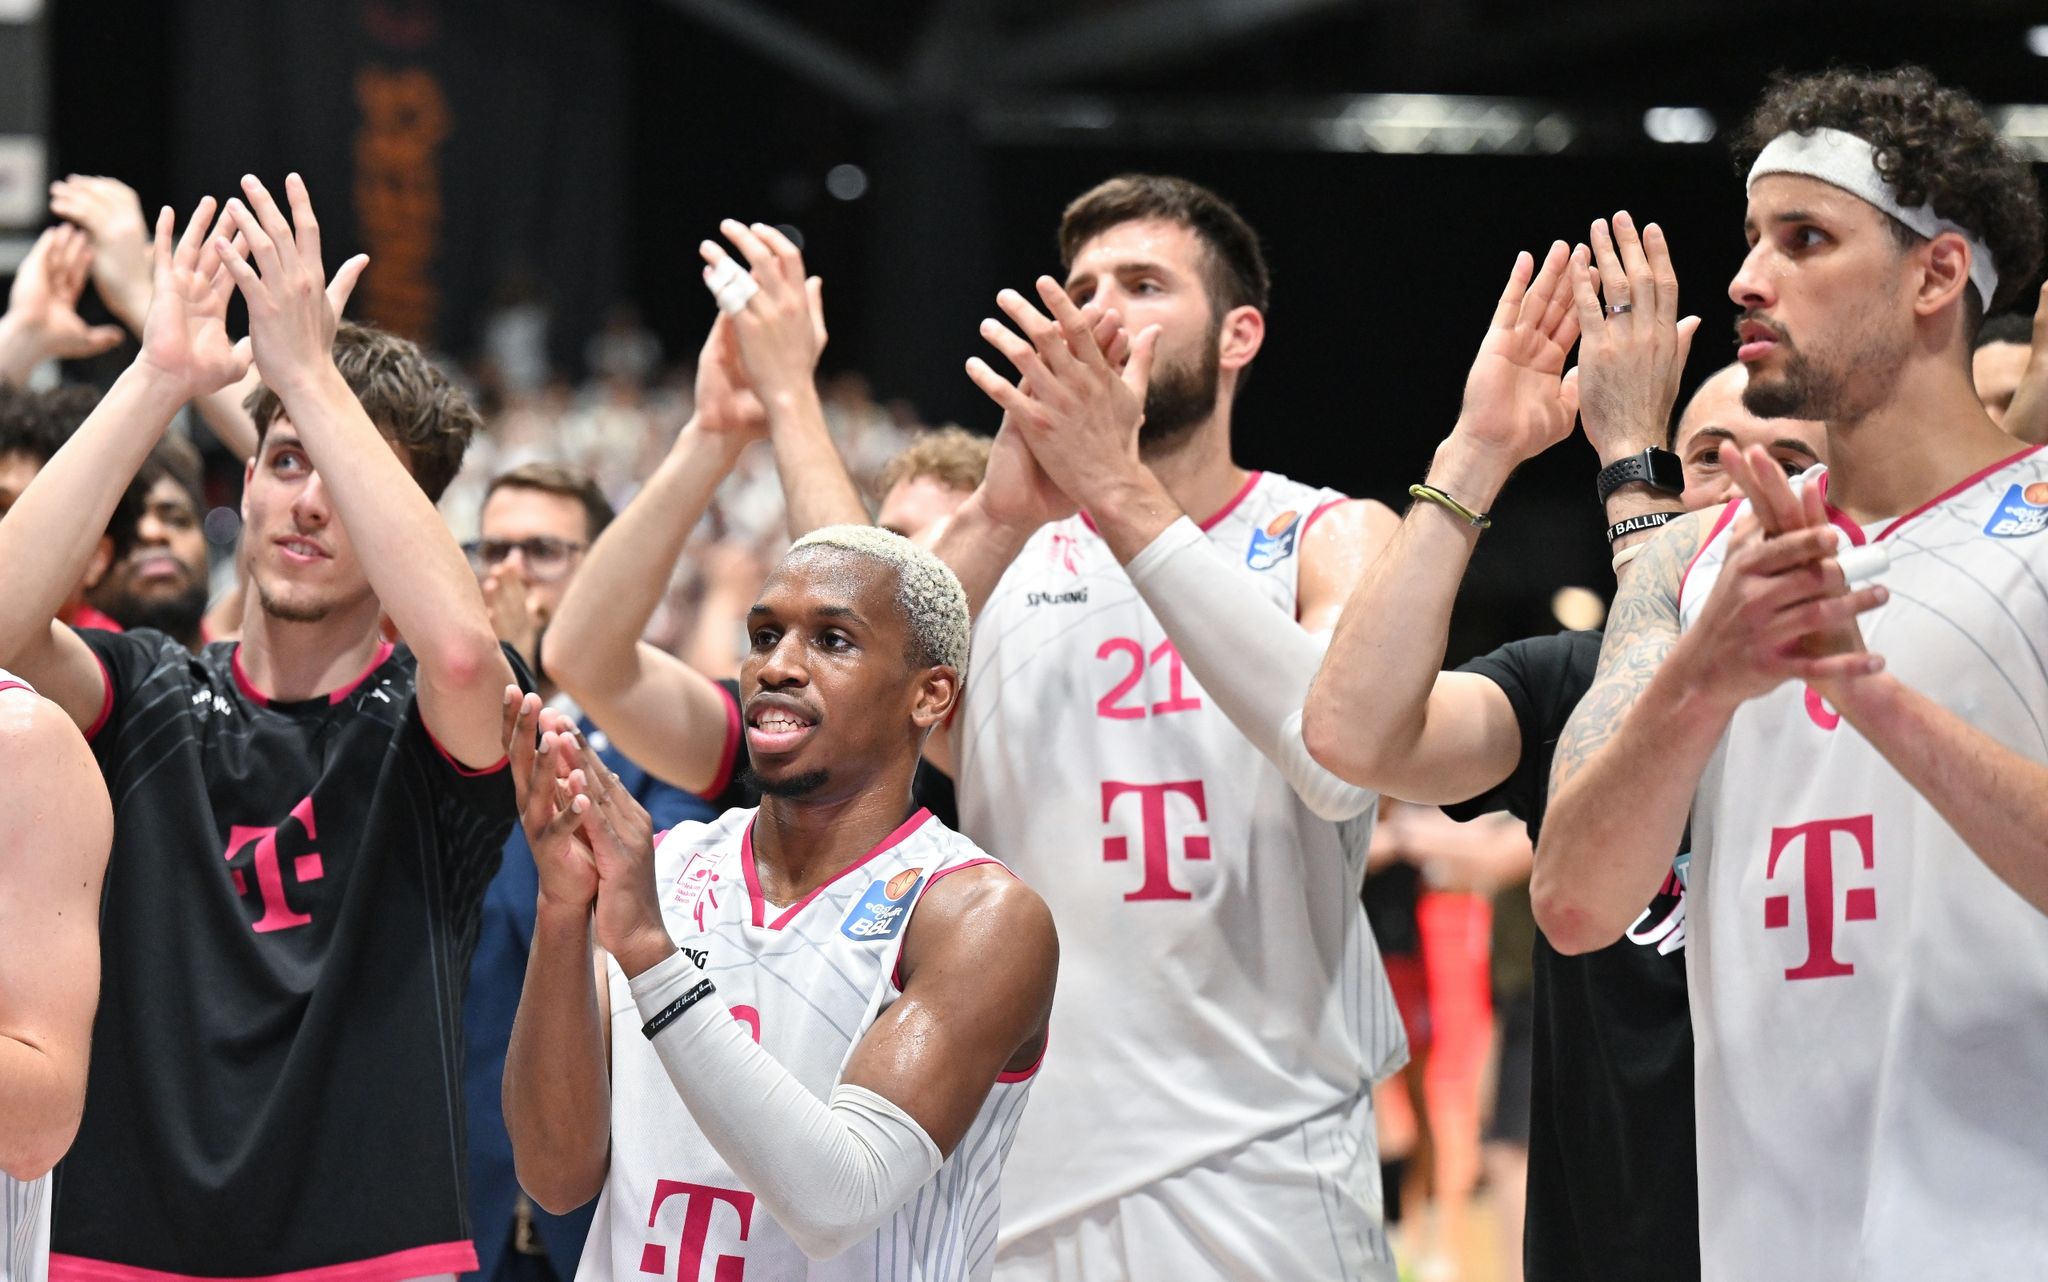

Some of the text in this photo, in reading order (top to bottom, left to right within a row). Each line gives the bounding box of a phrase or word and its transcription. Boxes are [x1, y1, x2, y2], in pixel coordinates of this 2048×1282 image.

[1615, 513, 1669, 536] BALLIN'
[1096, 638, 1201, 720] 21
[848, 917, 894, 936] BBL
